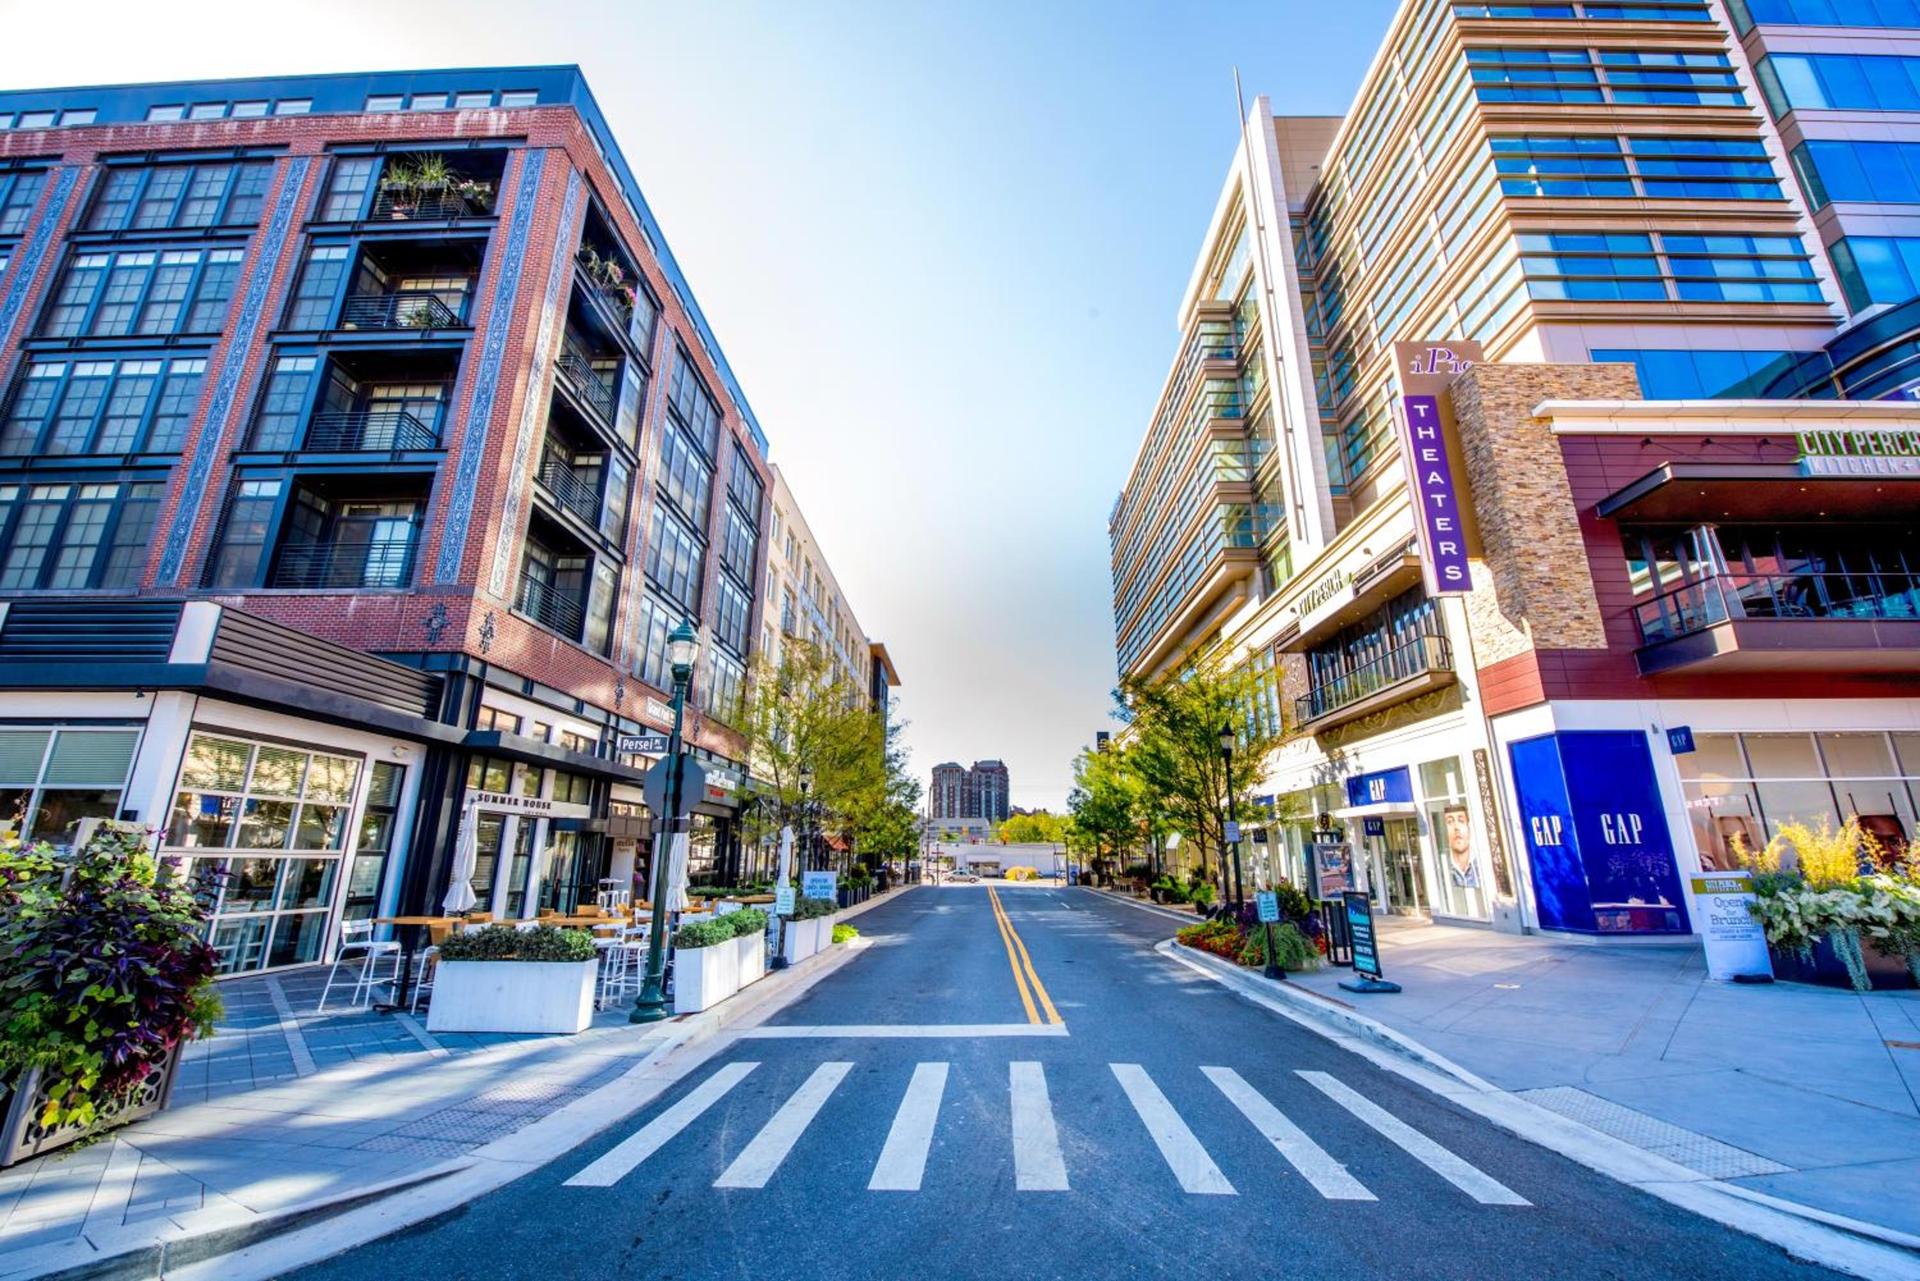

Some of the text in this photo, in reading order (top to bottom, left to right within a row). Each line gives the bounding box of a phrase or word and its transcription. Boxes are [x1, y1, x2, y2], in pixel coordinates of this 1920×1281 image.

[1800, 430, 1920, 455] CITY PERCH
[1807, 456, 1901, 474] KITCHEN
[1413, 404, 1463, 580] THEATERS
[622, 738, 653, 751] Persei
[1671, 733, 1687, 748] GAP
[1369, 778, 1385, 801] GAP
[477, 792, 552, 810] SUMMER HOUSE
[1368, 821, 1380, 831] GAP
[1531, 815, 1563, 847] GAP
[1600, 813, 1643, 845] GAP
[1713, 896, 1741, 910] Open
[1710, 914, 1753, 925] Brunch
